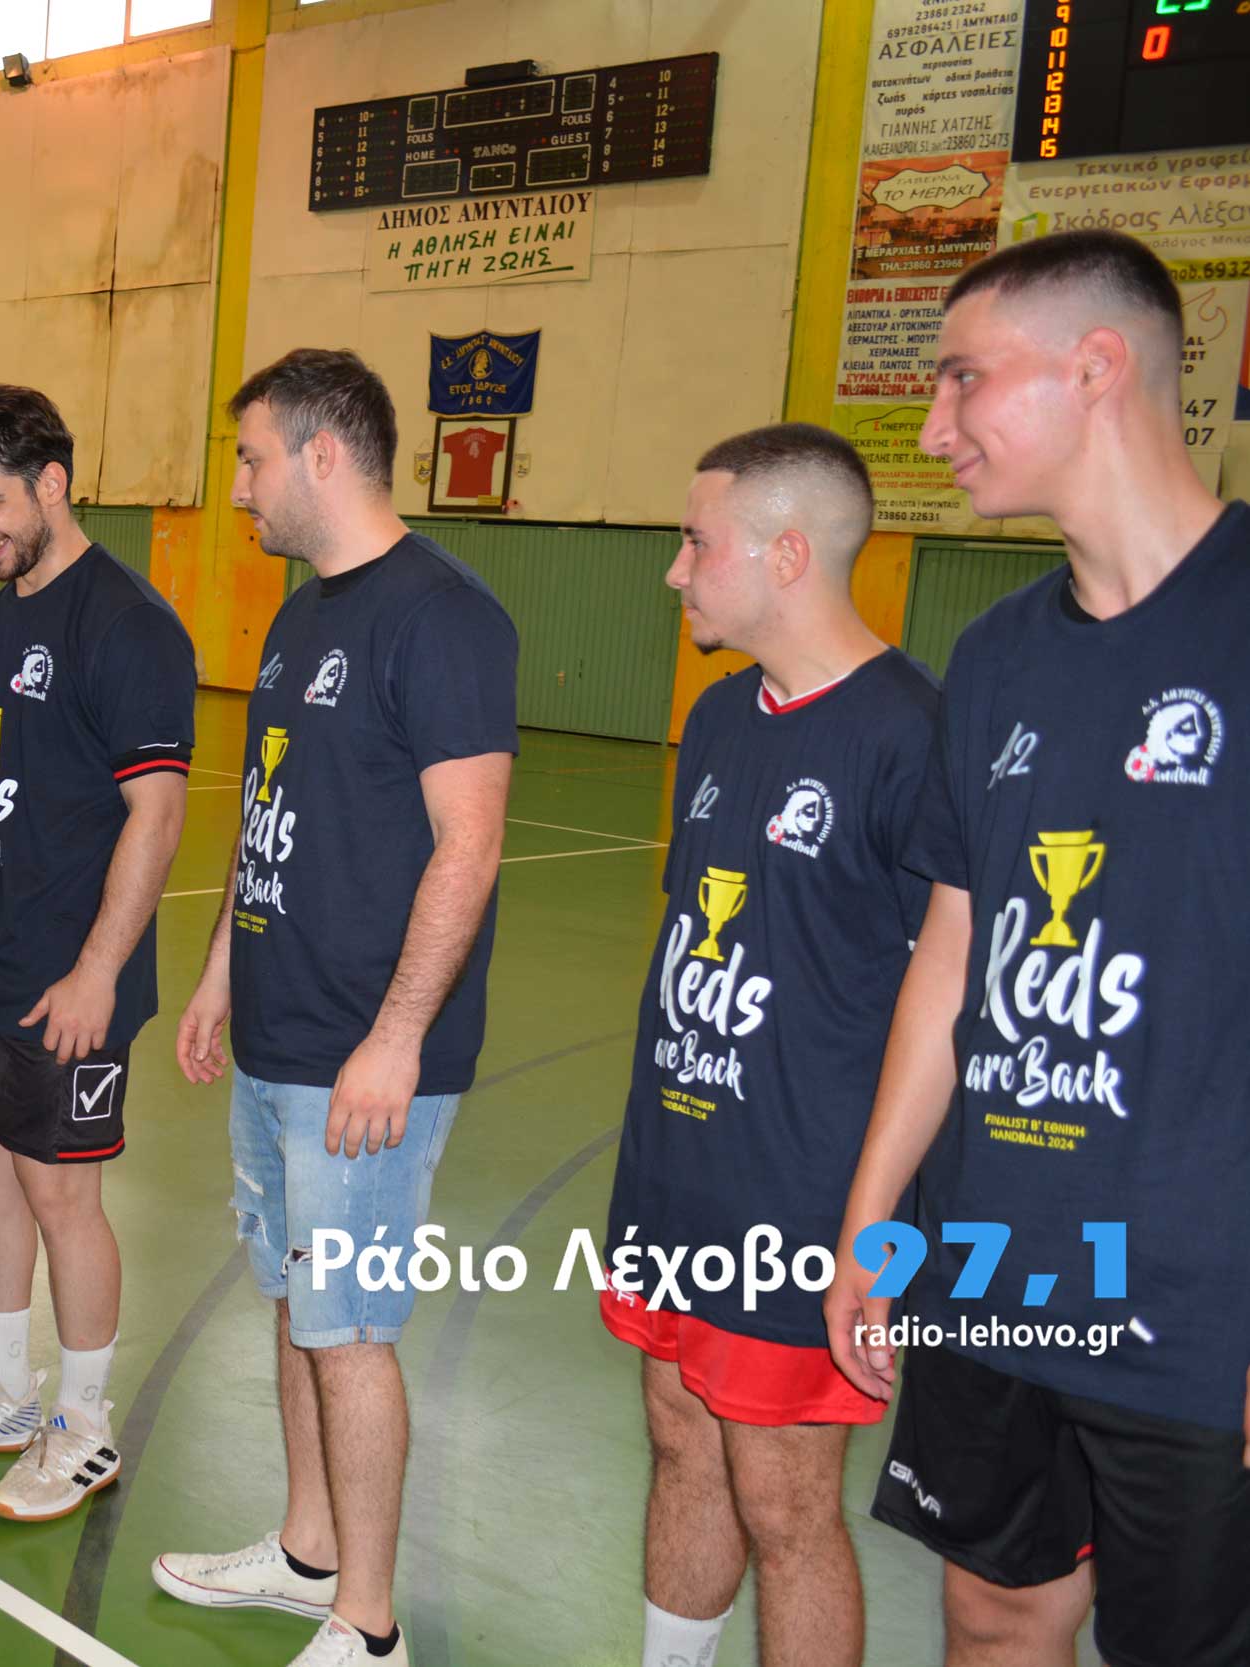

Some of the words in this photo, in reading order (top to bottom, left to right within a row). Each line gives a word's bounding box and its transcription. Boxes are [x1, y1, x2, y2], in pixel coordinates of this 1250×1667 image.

[878, 30, 1017, 60] ΑΣΦΑΛΕΙΕΣ
[1050, 27, 1068, 47] 10
[1141, 25, 1171, 61] 0
[1048, 50, 1066, 69] 11
[658, 70, 671, 83] 10
[1046, 72, 1064, 92] 12
[657, 87, 669, 100] 11
[656, 104, 668, 117] 12
[1044, 94, 1062, 114] 13
[358, 111, 369, 123] 10
[561, 113, 592, 126] FOULS
[881, 120, 937, 137] ΓΙΑΝΝΗΣ
[941, 115, 992, 133] ΧΑΤΖΗΣ
[1042, 117, 1060, 136] 14
[357, 127, 367, 137] 11
[654, 121, 667, 134] 13
[357, 142, 367, 152] 12
[406, 132, 434, 145] FOULS
[550, 132, 591, 146] GUEST
[653, 138, 666, 151] 14
[1040, 138, 1057, 158] 15
[356, 156, 366, 167] 13
[405, 150, 436, 161] HOME
[651, 154, 664, 168] 15
[354, 171, 365, 182] 14
[1076, 158, 1159, 177] Τεχνικό
[354, 186, 364, 197] 15
[883, 190, 903, 201] ΤΟ
[910, 184, 975, 199] ΜΕΡΑΚΙ
[1028, 176, 1171, 200] Ενεργειακών
[377, 205, 451, 231] ΔΗΜΟΣ
[456, 191, 592, 223] ΑΜΥΝΤΑΙΟΥ
[1052, 208, 1161, 232] Σκόδρας
[388, 241, 401, 259] Η
[412, 229, 496, 257] ΑΘΛΗΣΗ
[508, 220, 575, 245] ΕΙΝΑΙ
[404, 256, 471, 282] ΠΗΓΗ
[483, 247, 553, 273] ΖΩΗΣ
[891, 438, 918, 448] ΑΥΤΟ
[243, 860, 287, 915] Back
[659, 914, 772, 1037] Reds
[980, 897, 1145, 1044] Reds
[677, 1029, 746, 1101] Back
[965, 1050, 1016, 1093] are
[1015, 1034, 1128, 1118] Back
[984, 1112, 1029, 1130] FINALIST
[989, 1128, 1045, 1147] HANDBALL
[1047, 1135, 1075, 1151] 2024
